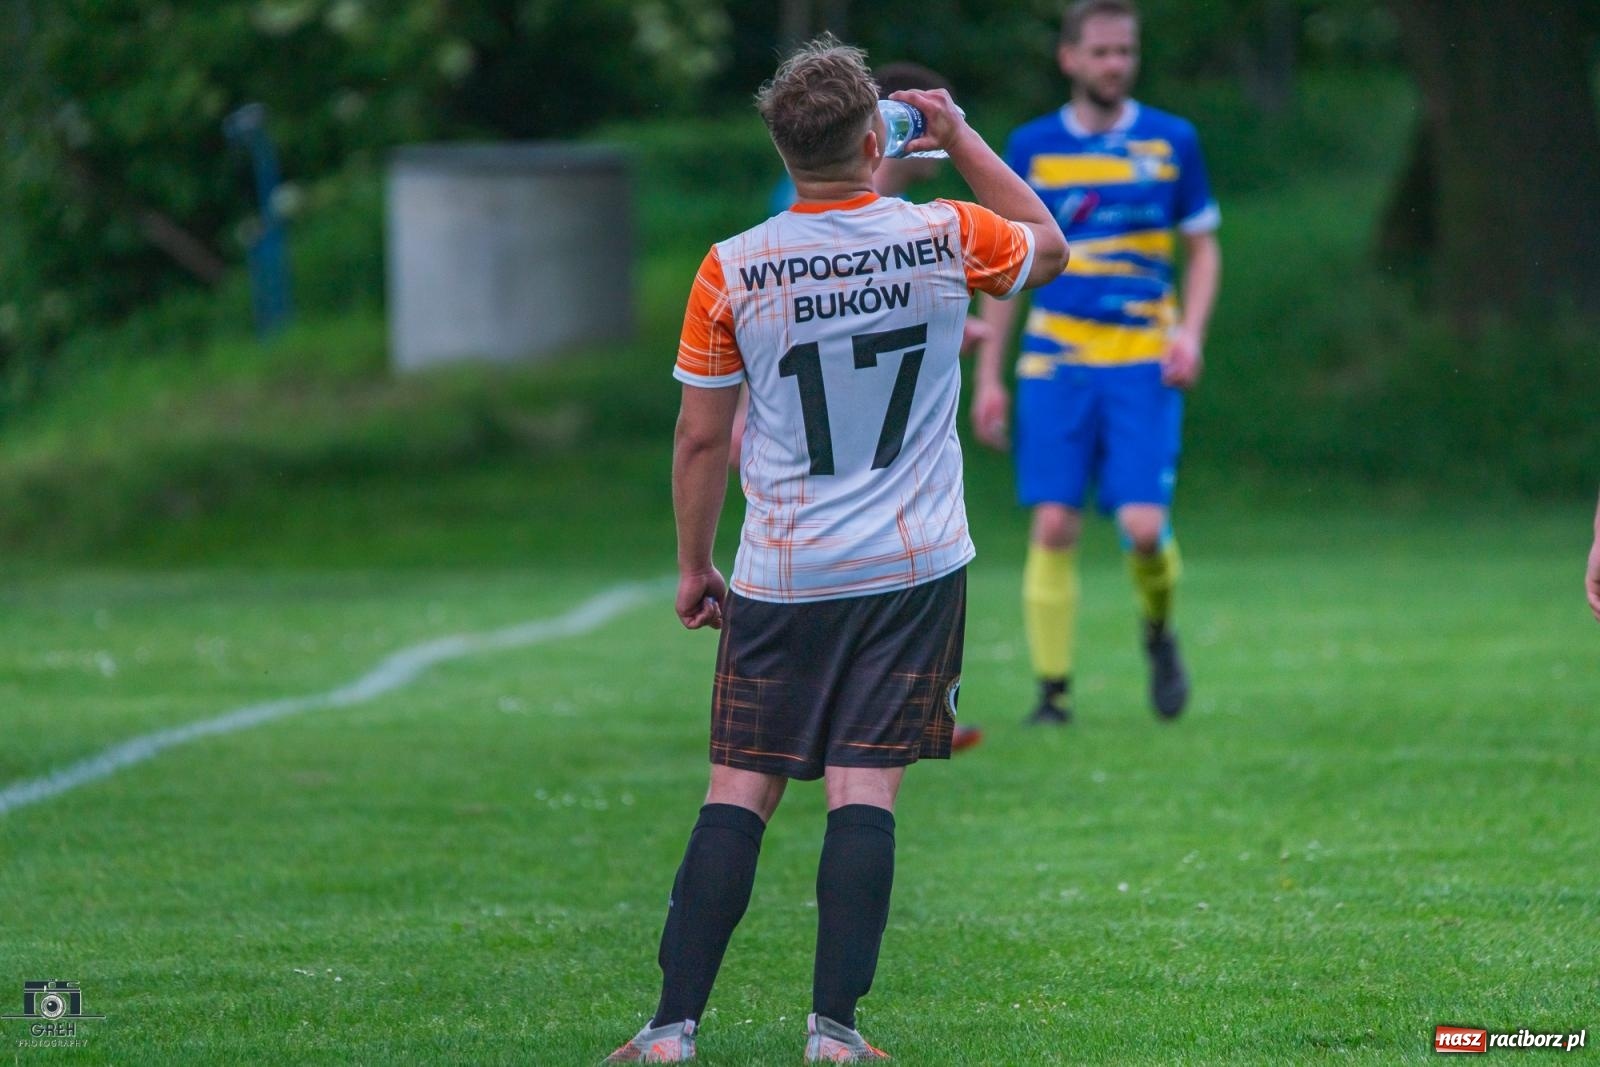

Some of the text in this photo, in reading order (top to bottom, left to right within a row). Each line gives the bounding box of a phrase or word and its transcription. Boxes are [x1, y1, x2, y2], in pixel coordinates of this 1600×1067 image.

[739, 234, 955, 291] WYPOCZYNEK
[794, 277, 911, 323] BUKÓW
[778, 323, 928, 476] 17
